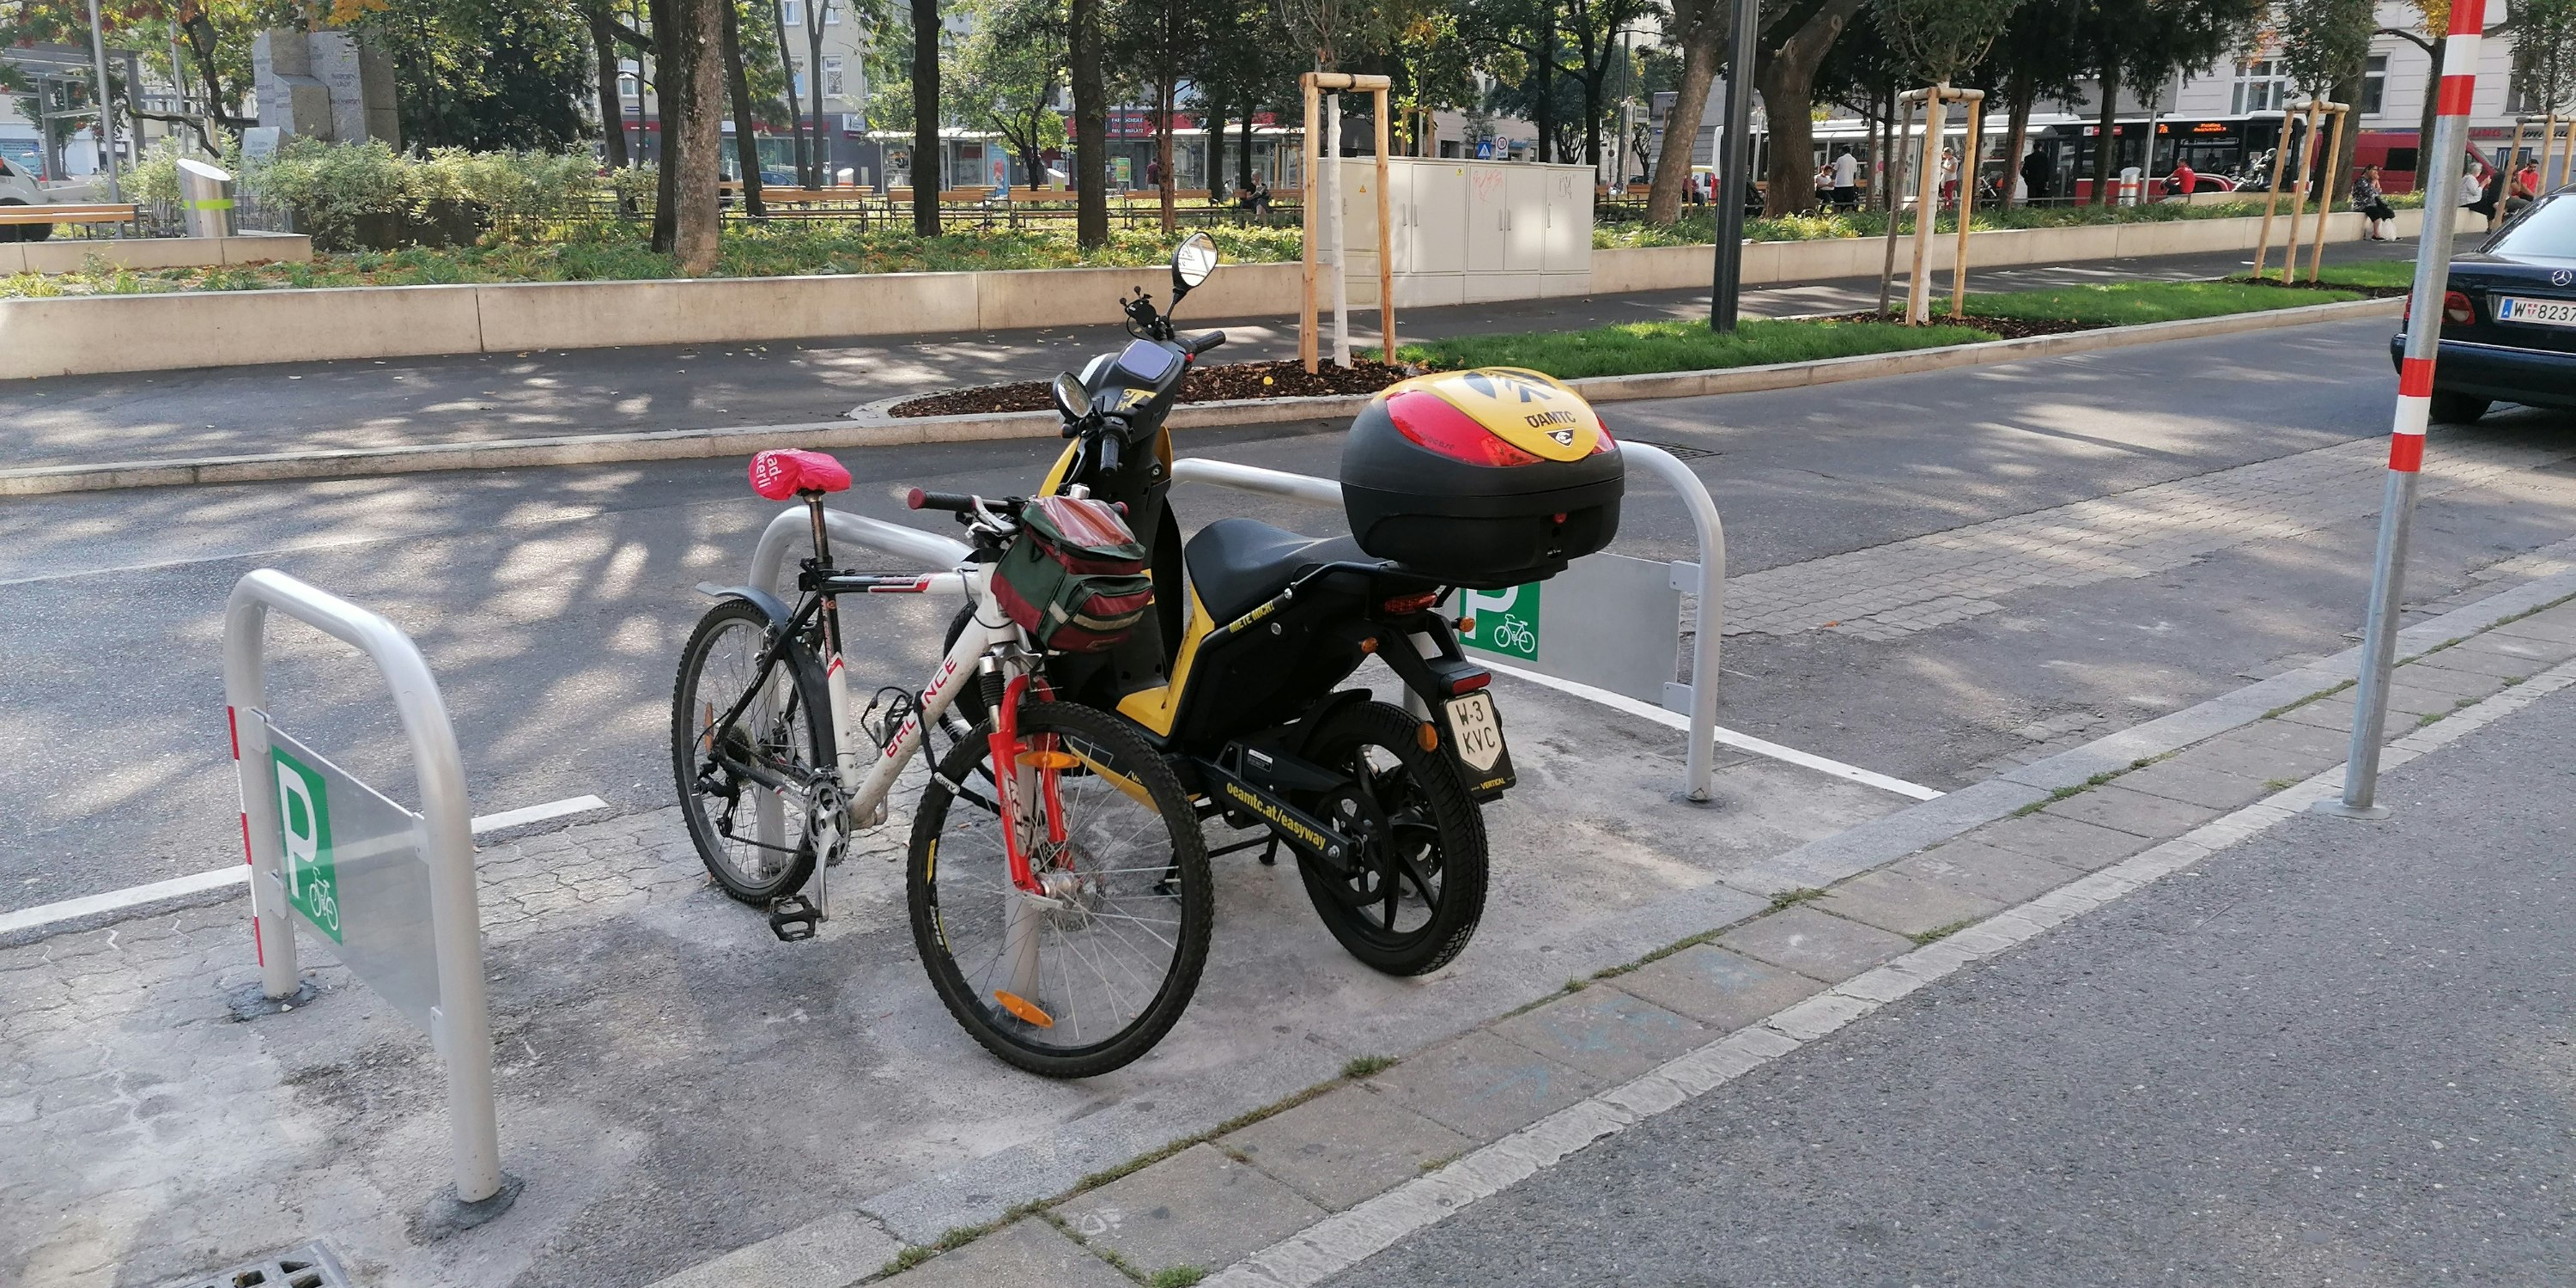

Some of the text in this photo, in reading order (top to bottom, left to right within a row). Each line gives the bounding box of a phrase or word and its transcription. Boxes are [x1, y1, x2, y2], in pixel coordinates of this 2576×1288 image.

[2514, 302, 2526, 317] W
[1524, 410, 1577, 428] ÖAMTC
[885, 654, 957, 758] BALNCE
[1462, 726, 1495, 755] KVC
[276, 760, 318, 899] P
[1226, 781, 1327, 850] oeamtc.at/easyway
